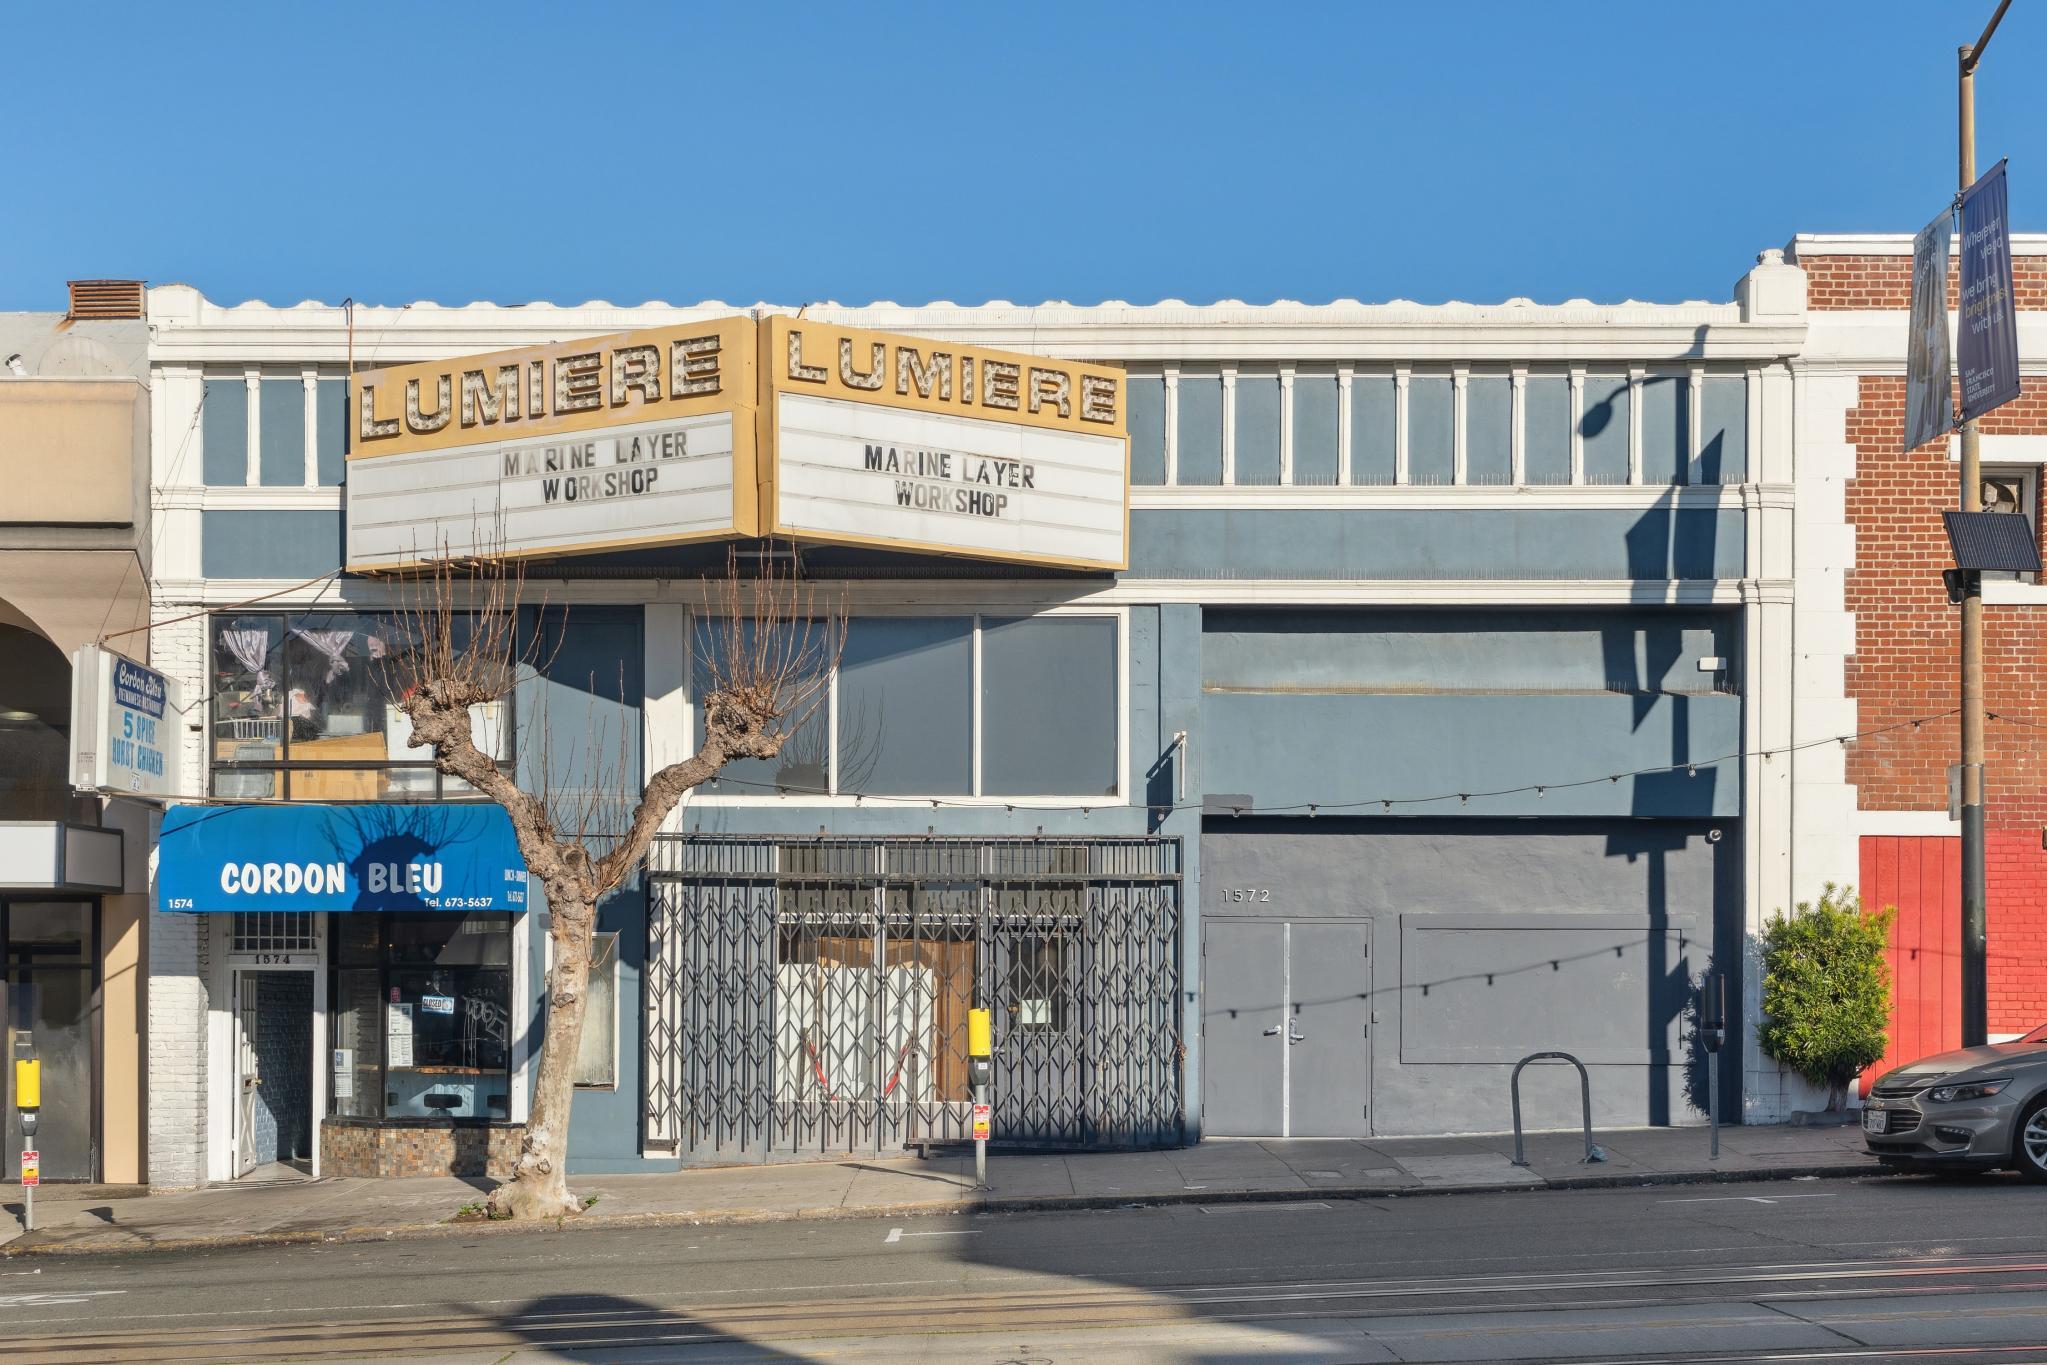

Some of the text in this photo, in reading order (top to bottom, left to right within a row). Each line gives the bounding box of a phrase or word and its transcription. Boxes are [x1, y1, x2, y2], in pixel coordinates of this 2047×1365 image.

[1964, 217, 2000, 251] Wherever
[1962, 286, 1976, 300] we
[1972, 314, 1991, 334] with
[361, 334, 723, 441] LUMIERE
[787, 330, 1117, 425] LUMIERE
[1967, 382, 1981, 394] STATE
[504, 431, 687, 477] MARINE LAYER
[865, 444, 1036, 489] MARINE LAYER
[543, 467, 658, 503] WORKSHOP
[895, 480, 1008, 518] WORKSHOP
[119, 663, 144, 691] Cordon
[124, 711, 155, 745] 5 SPICE
[137, 744, 163, 777] CHICKEN
[220, 862, 443, 895] CORDON BLEU
[168, 898, 193, 909] 1574
[424, 897, 493, 908] Tel. 673-5637
[1221, 888, 1271, 903] 1572
[254, 954, 291, 966] 1574
